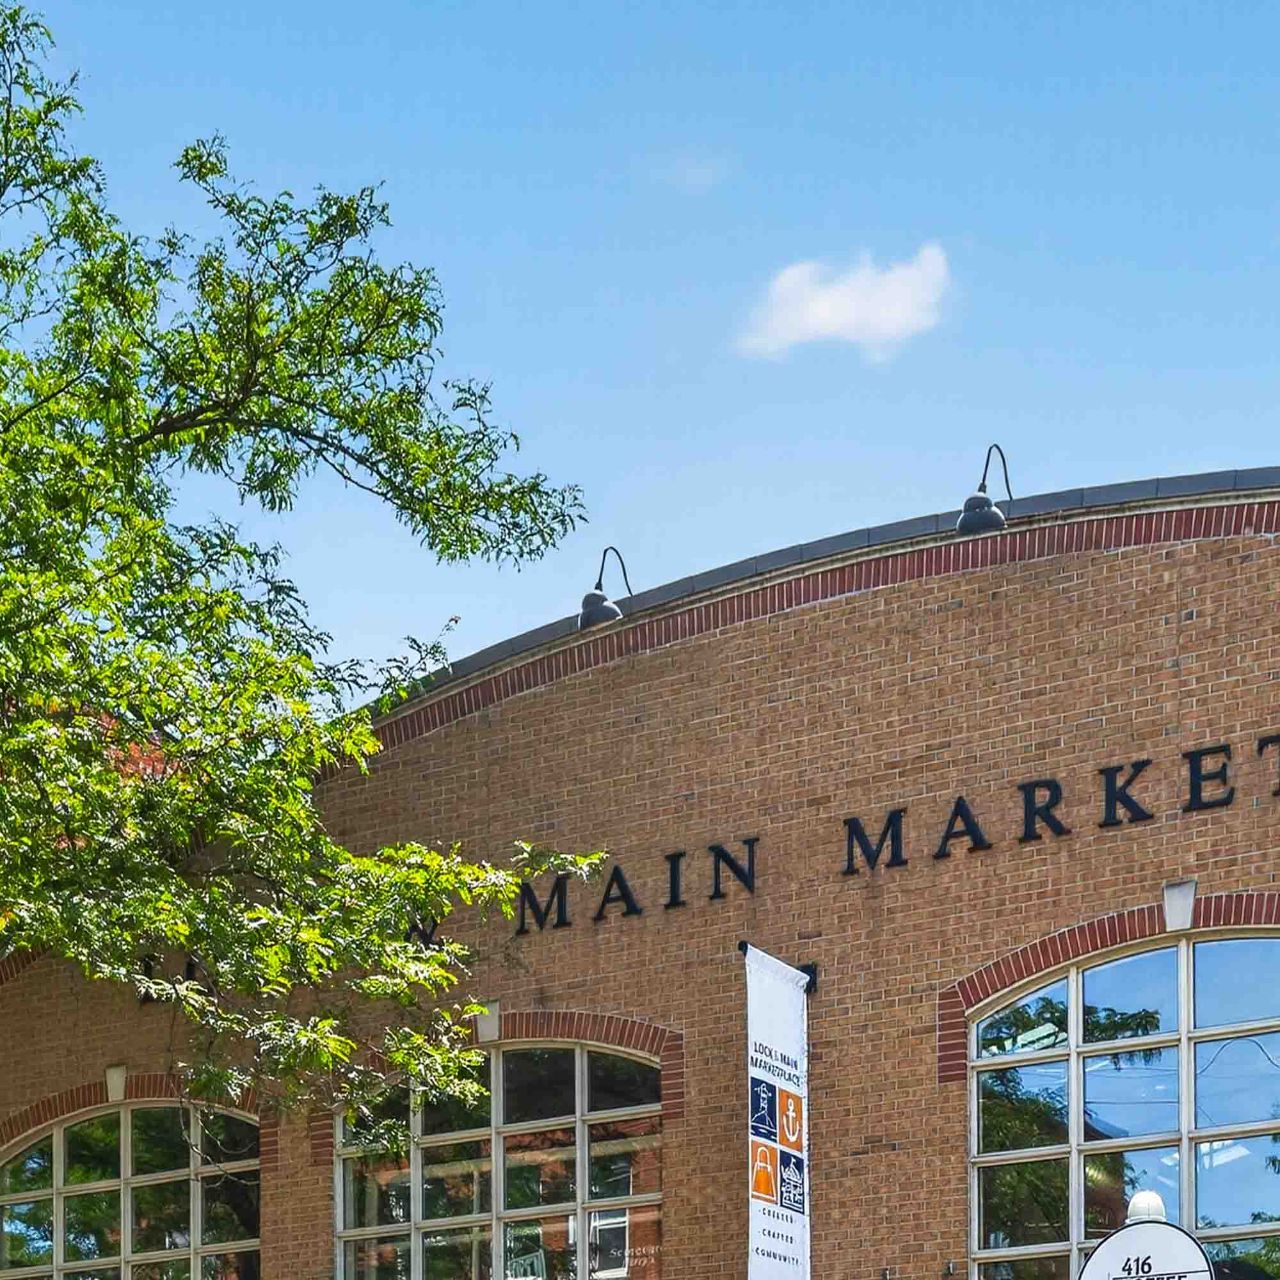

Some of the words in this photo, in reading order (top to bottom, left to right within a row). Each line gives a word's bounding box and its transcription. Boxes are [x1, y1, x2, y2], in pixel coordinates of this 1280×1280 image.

[516, 837, 760, 935] MAIN
[754, 1041, 773, 1060] LOCK
[1122, 1256, 1152, 1276] 416
